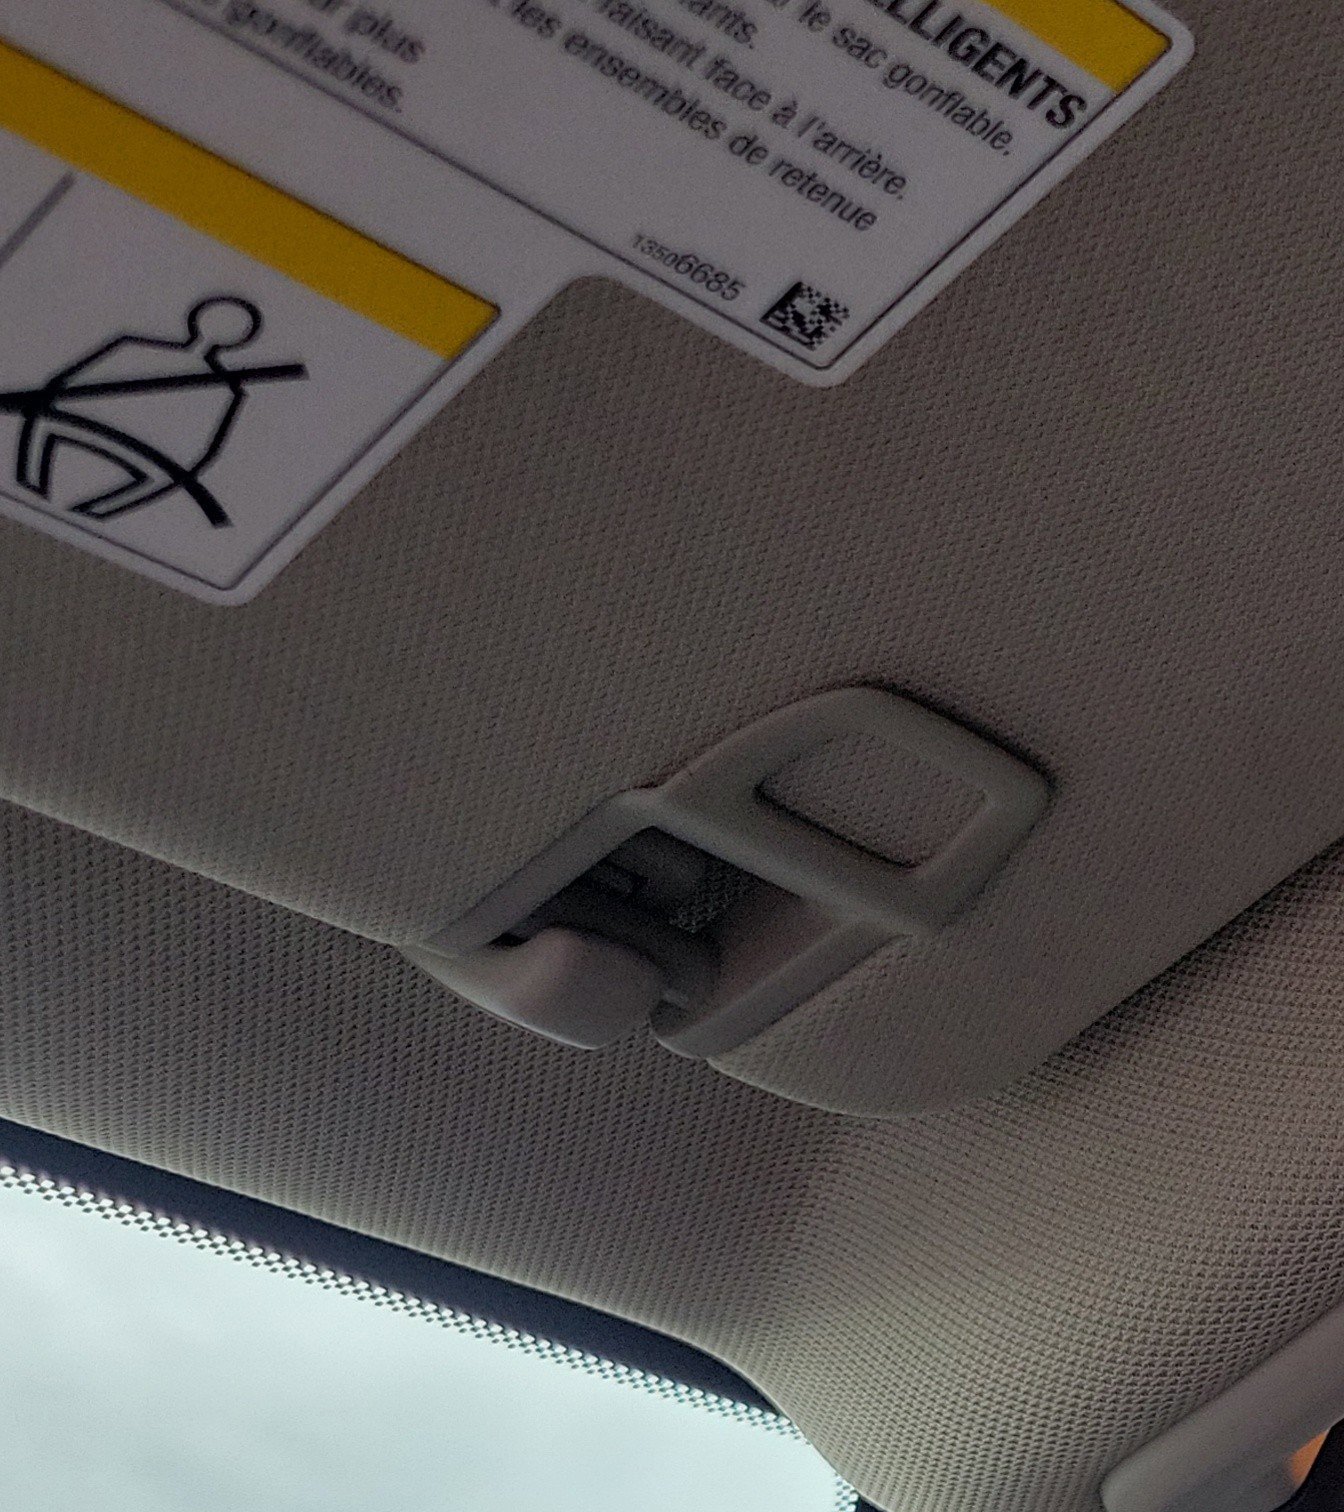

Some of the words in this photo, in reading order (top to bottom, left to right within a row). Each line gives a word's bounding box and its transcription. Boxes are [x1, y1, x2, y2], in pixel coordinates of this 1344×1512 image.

[704, 56, 771, 112] face
[770, 96, 799, 129] à
[798, 115, 907, 200] l'arrière.
[832, 26, 888, 69] sac
[882, 62, 1012, 157] gonflable.
[866, 0, 1086, 129] LLIGENTS
[563, 31, 729, 140] ensembles
[728, 133, 769, 166] de
[768, 157, 878, 232] retenue
[631, 233, 747, 301] 13506685
